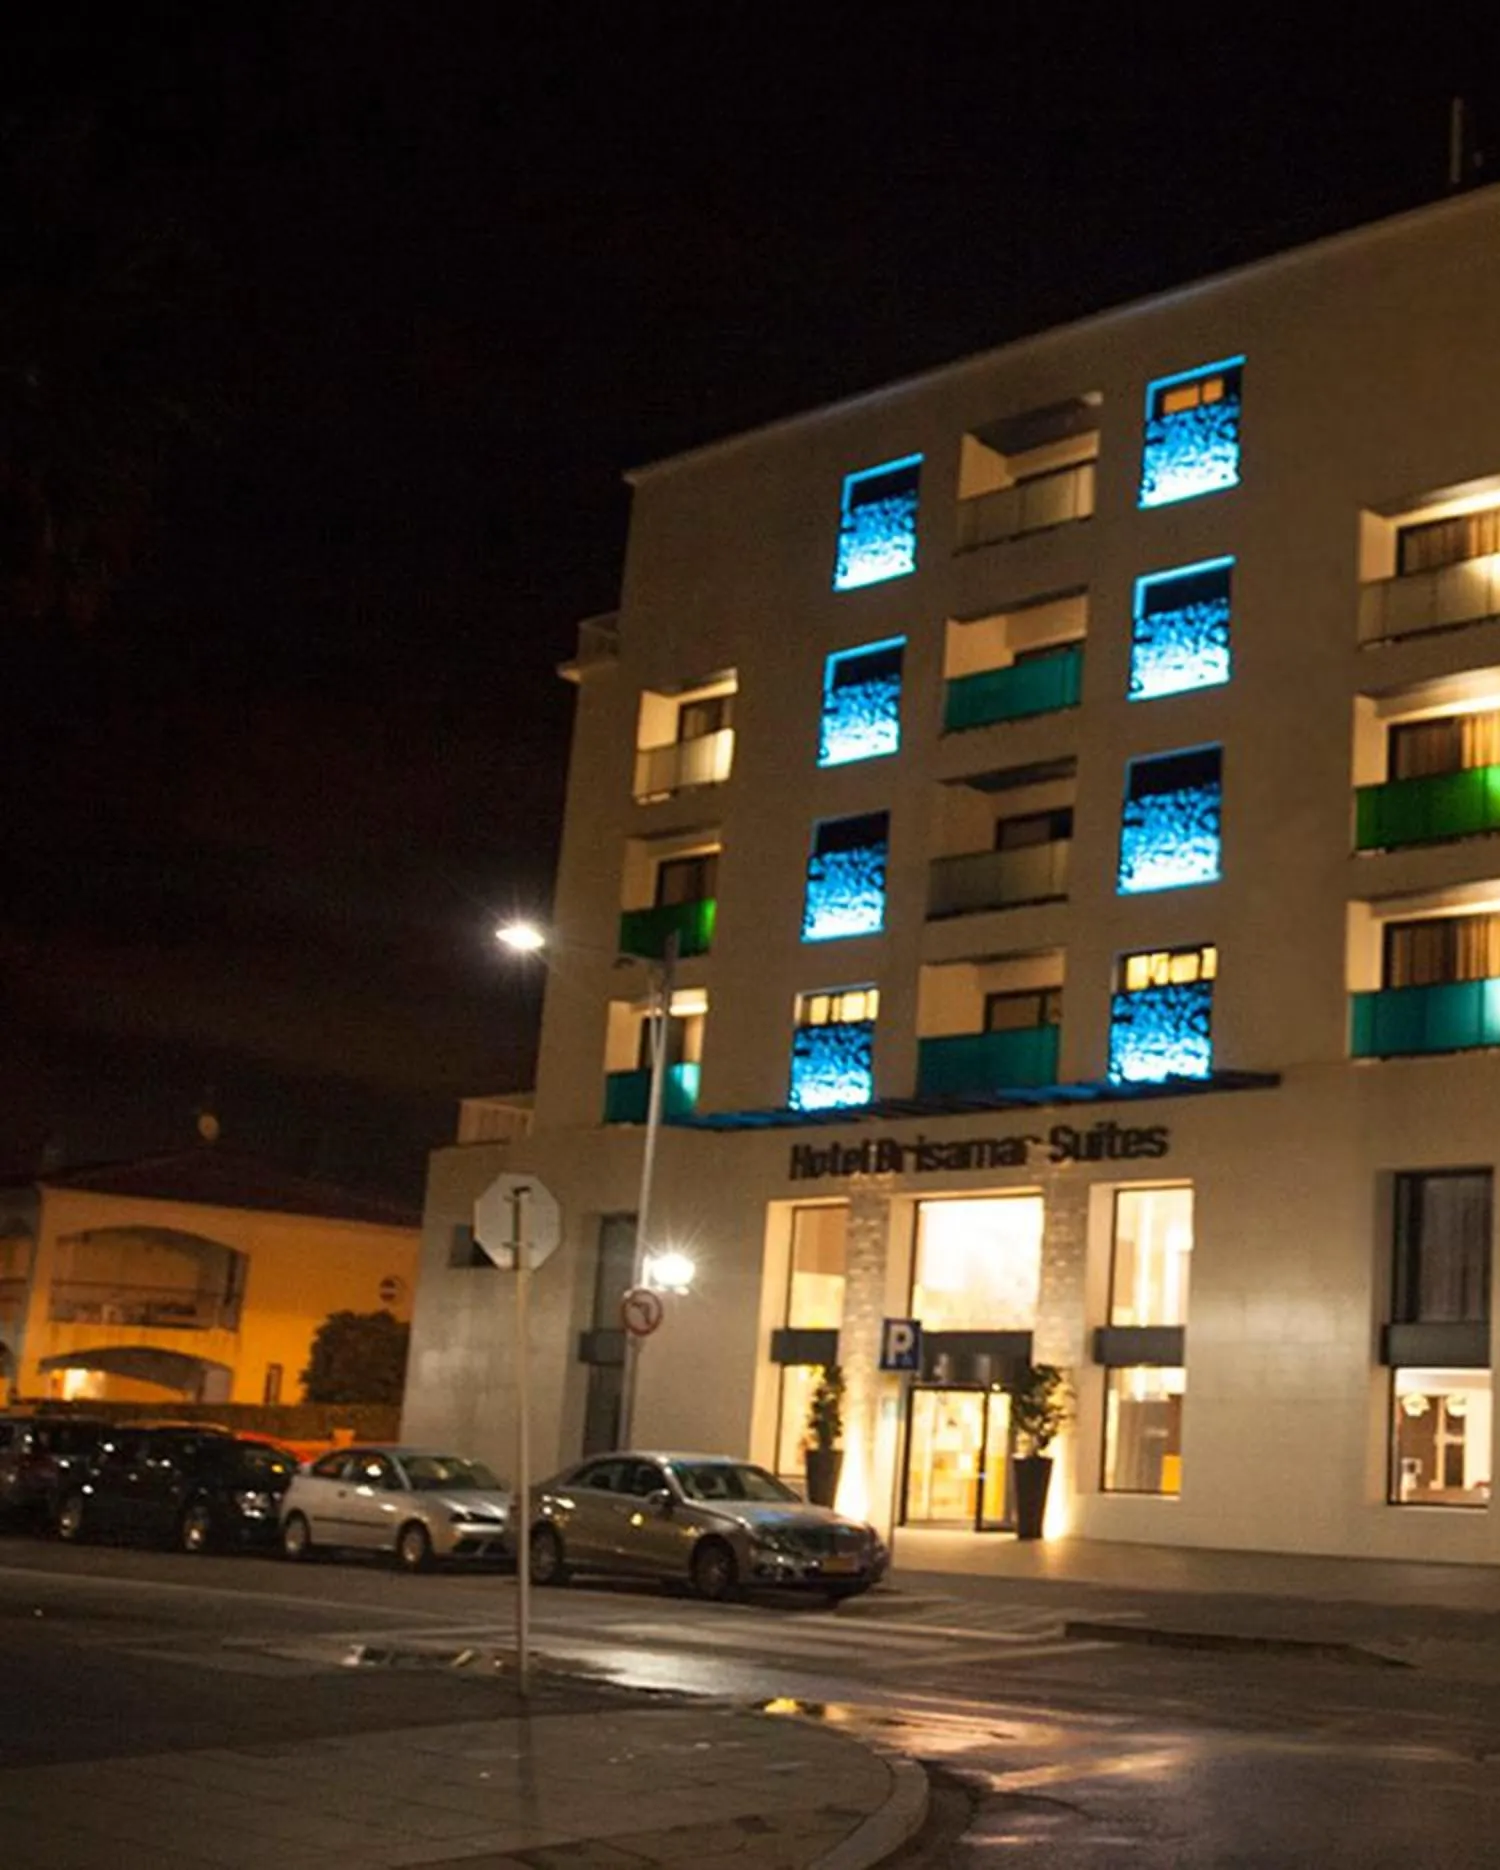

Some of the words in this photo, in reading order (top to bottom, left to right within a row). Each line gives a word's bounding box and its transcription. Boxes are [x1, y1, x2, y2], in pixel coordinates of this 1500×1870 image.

[789, 1139, 871, 1181] Hotel
[1048, 1121, 1169, 1163] Suites
[886, 1324, 914, 1366] P
